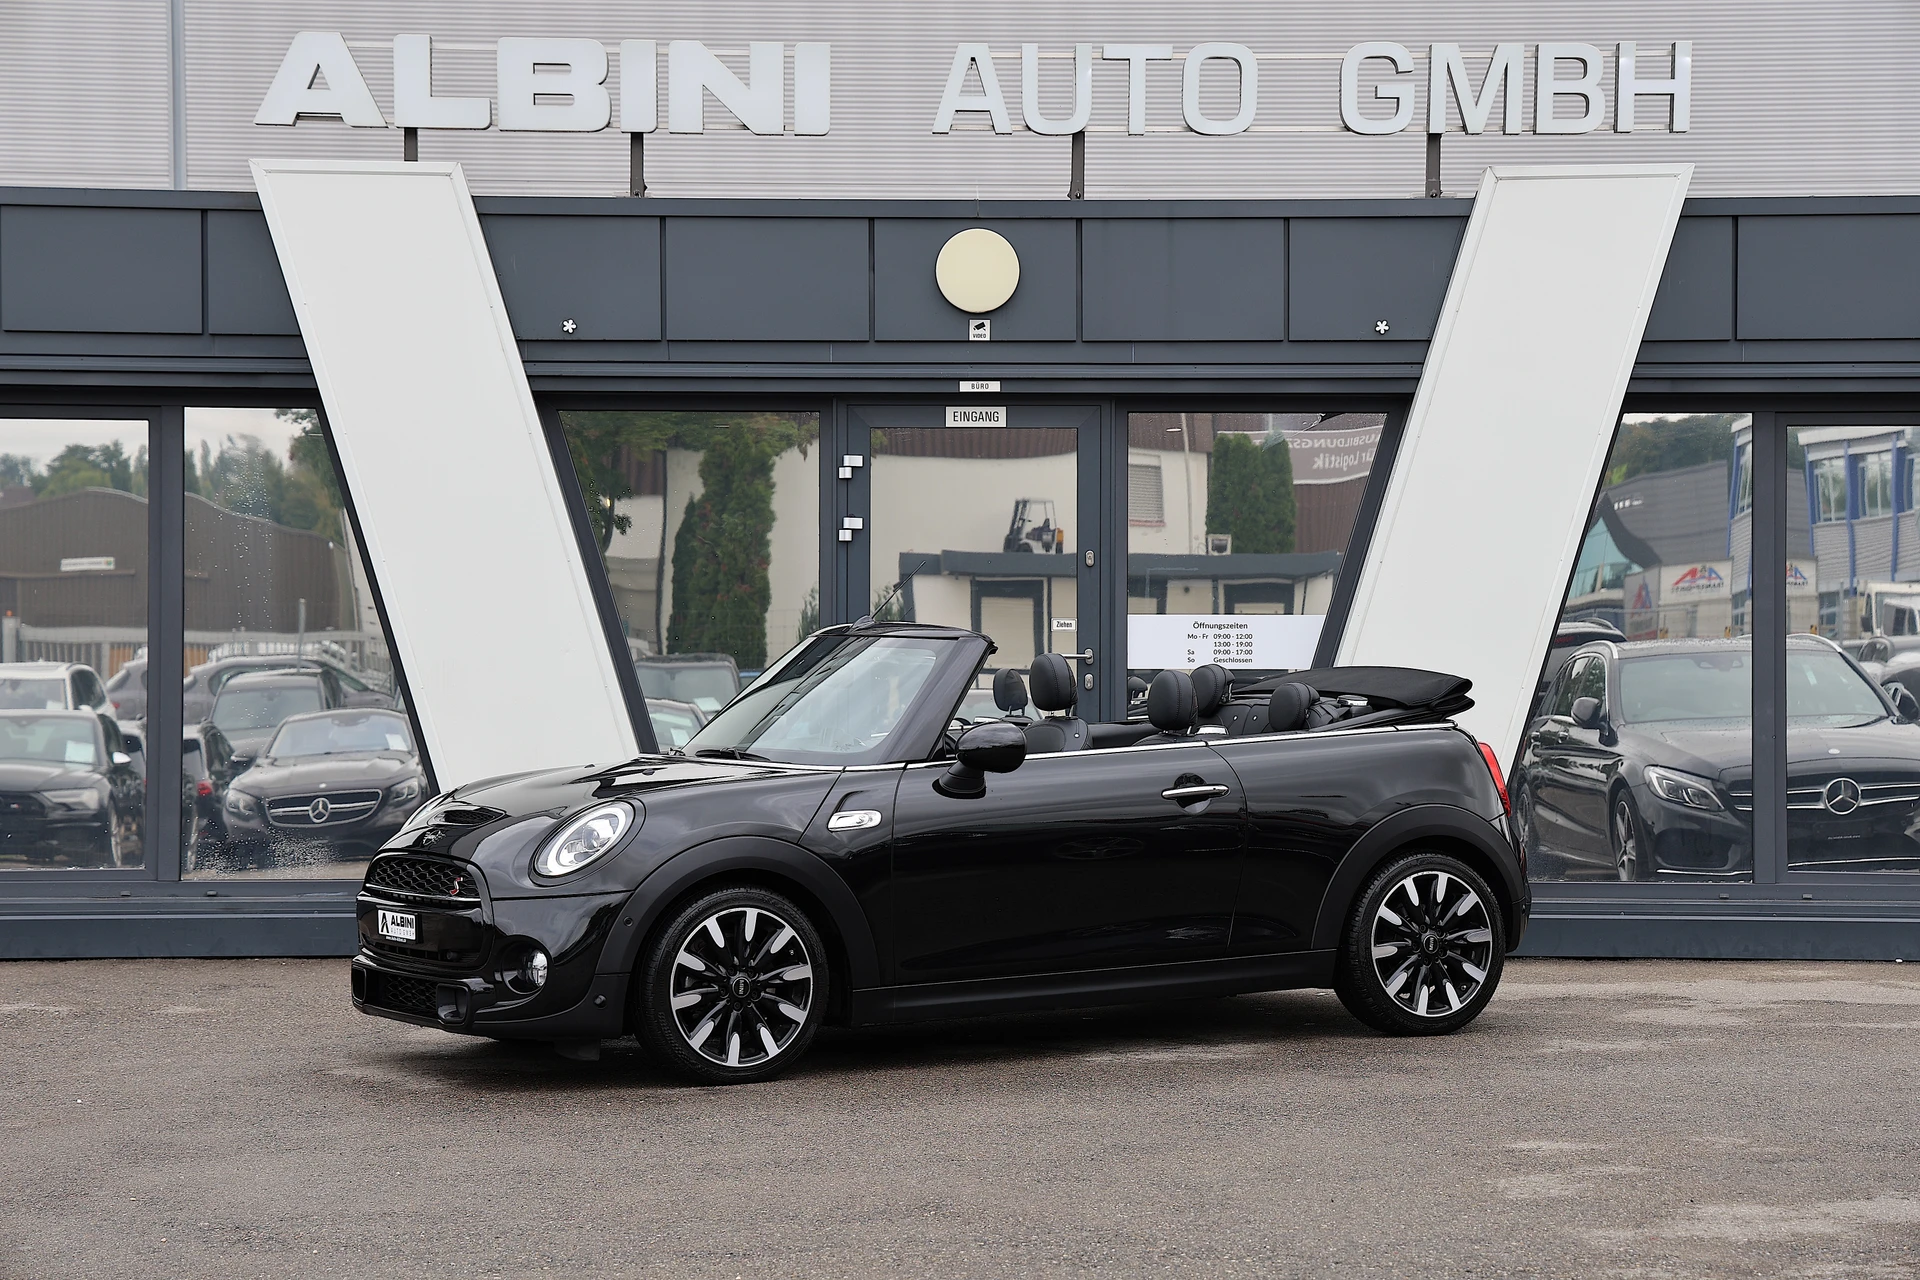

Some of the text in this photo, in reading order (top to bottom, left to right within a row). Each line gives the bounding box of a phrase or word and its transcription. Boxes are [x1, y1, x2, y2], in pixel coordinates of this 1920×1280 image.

[253, 31, 1693, 136] ALBINI AUTO GMBH
[971, 382, 990, 390] BÜRO
[953, 411, 1000, 422] EINGANG
[1056, 620, 1073, 628] Ziehen
[1192, 621, 1248, 630] Öffnungszeiten
[391, 914, 415, 929] ALBINI
